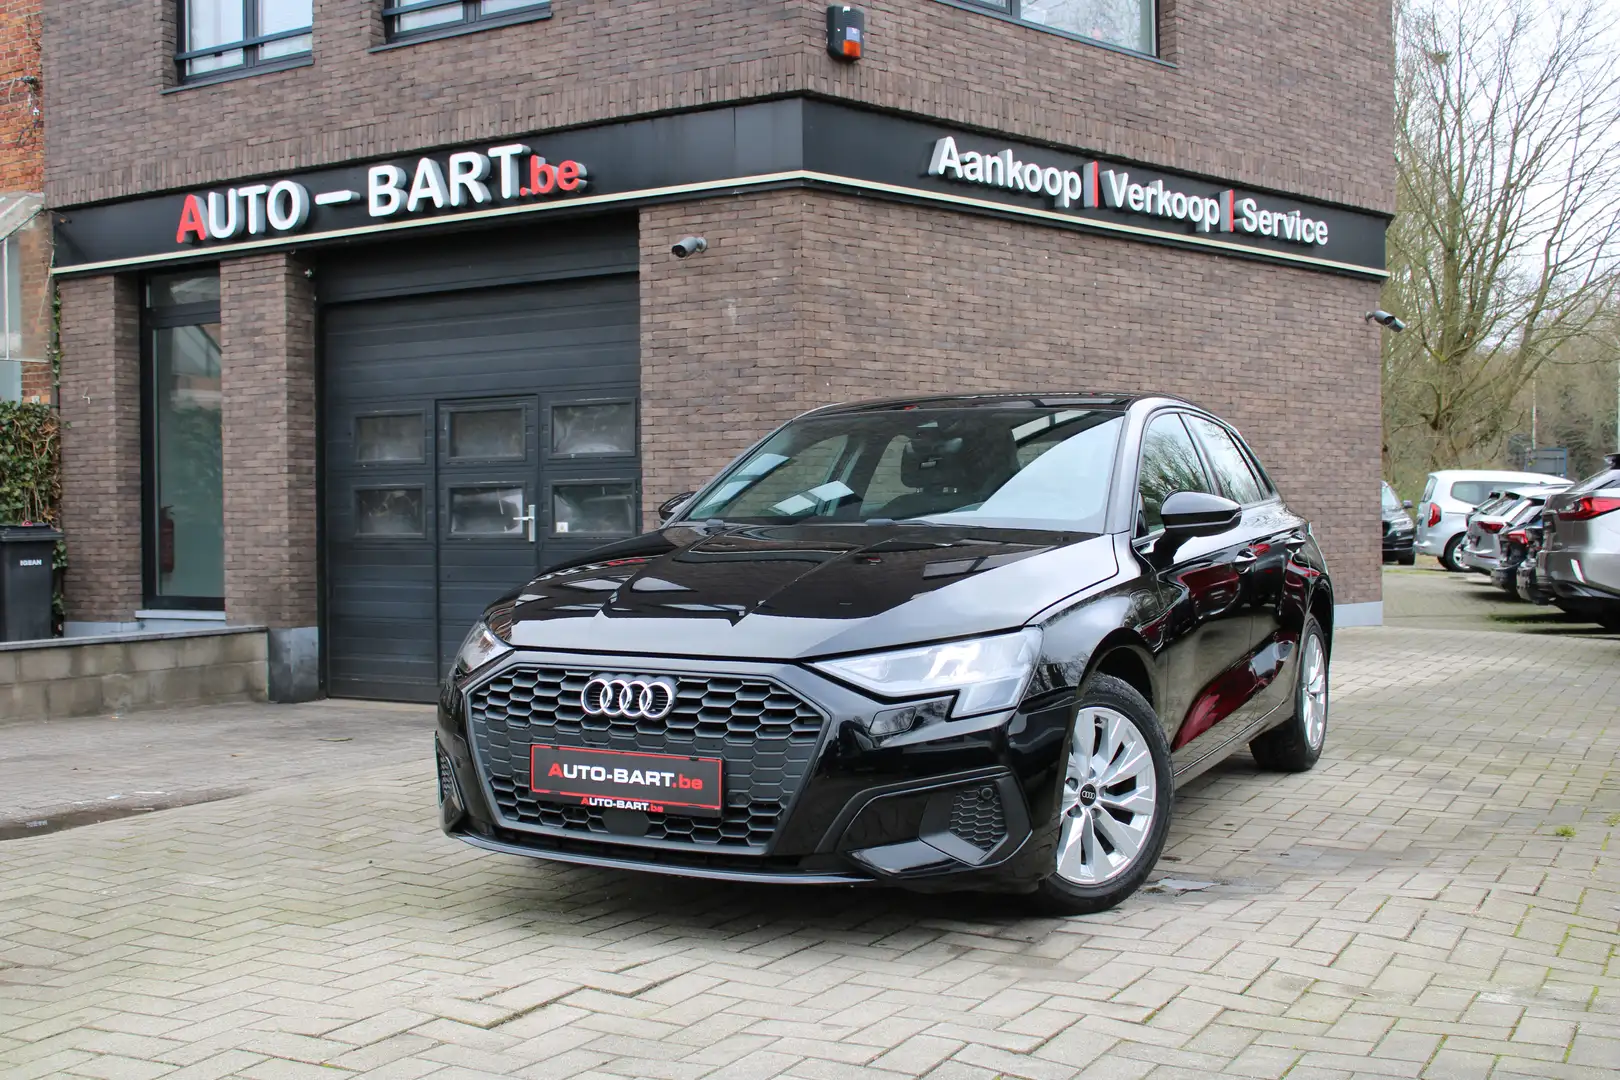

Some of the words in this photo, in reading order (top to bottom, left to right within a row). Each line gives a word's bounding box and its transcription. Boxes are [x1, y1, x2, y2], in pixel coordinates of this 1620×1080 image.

[931, 136, 1082, 207] Aankoop
[1102, 169, 1220, 232] Verkoop
[1238, 198, 1329, 246] Service
[547, 763, 704, 790] AUTO-BART.be
[580, 797, 664, 813] AUTO-BART.be
